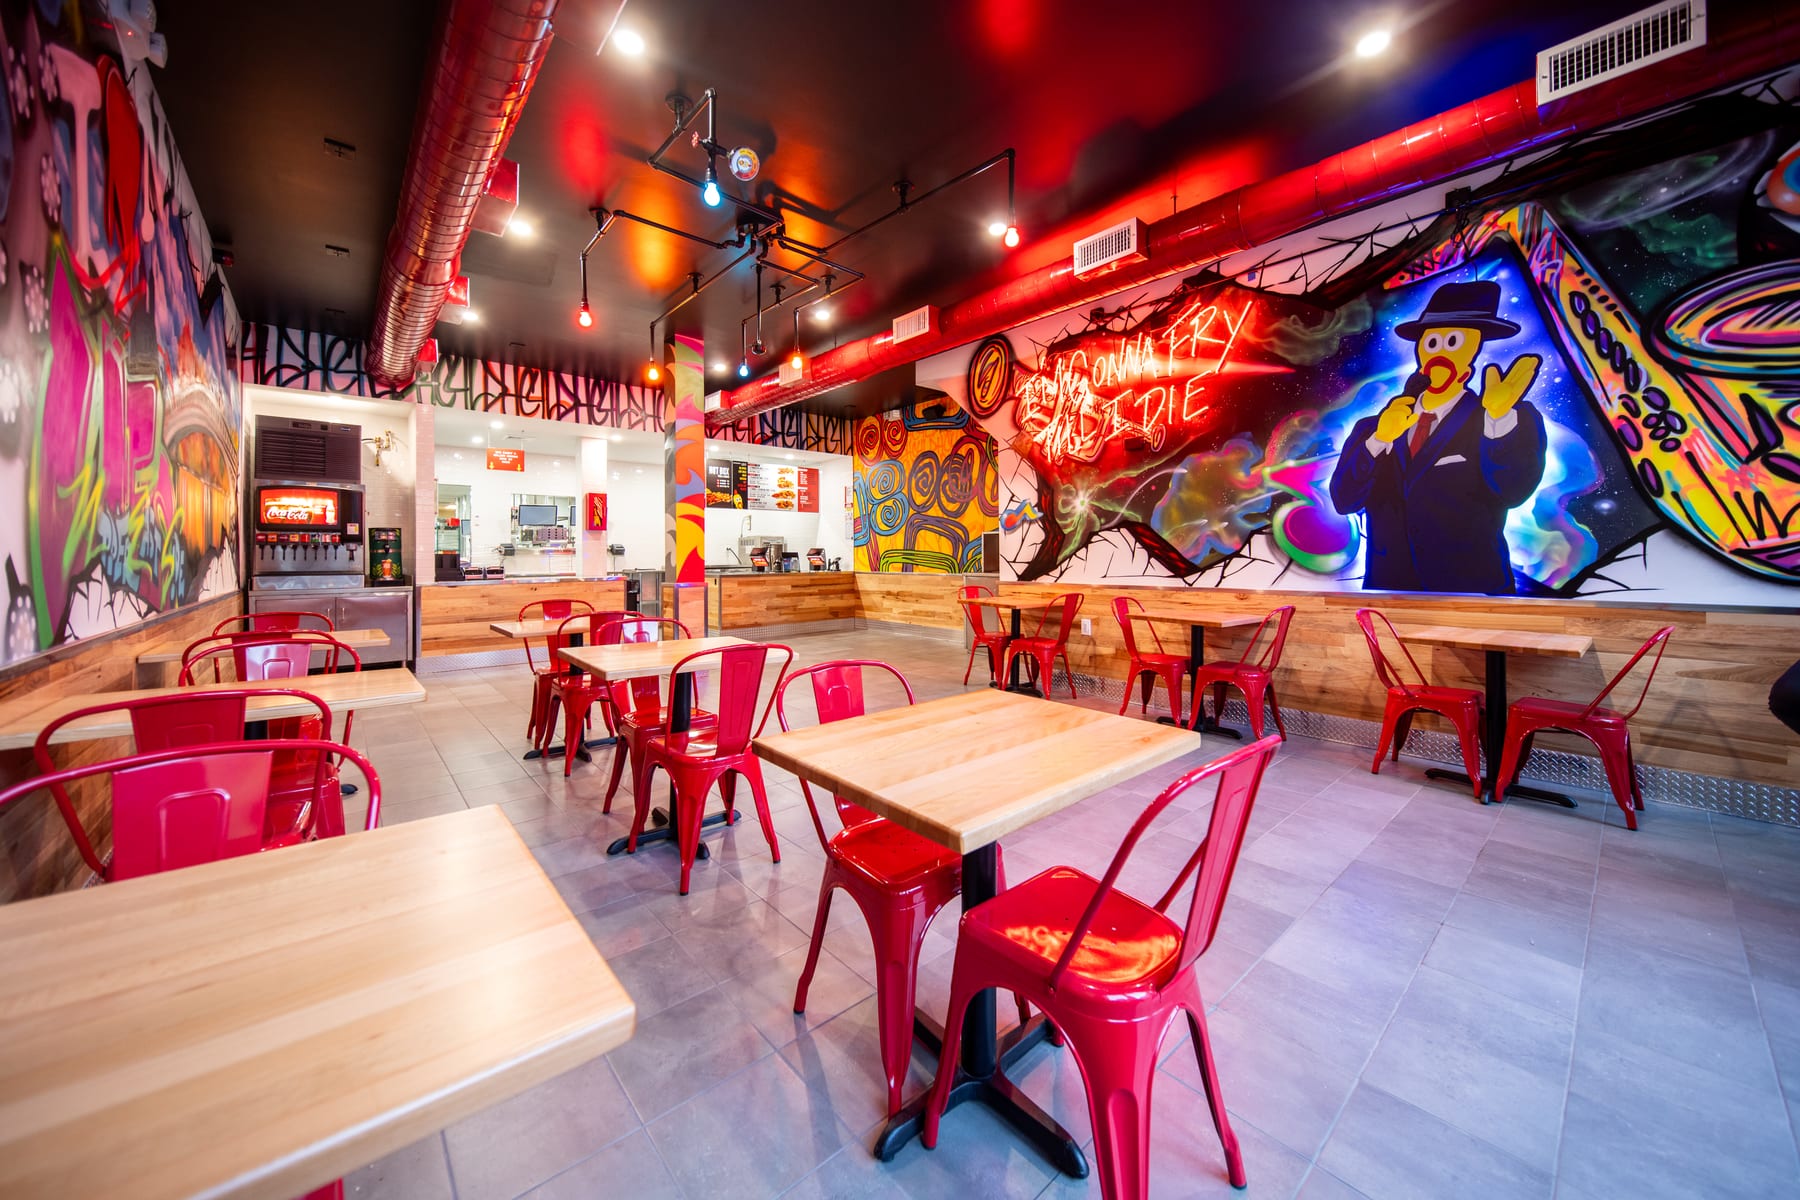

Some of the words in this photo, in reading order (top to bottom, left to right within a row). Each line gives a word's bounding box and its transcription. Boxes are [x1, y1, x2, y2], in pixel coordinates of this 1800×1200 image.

[1067, 332, 1158, 403] GONNA
[1162, 301, 1252, 376] FRY
[1101, 389, 1133, 441] I
[1134, 370, 1212, 431] DIE
